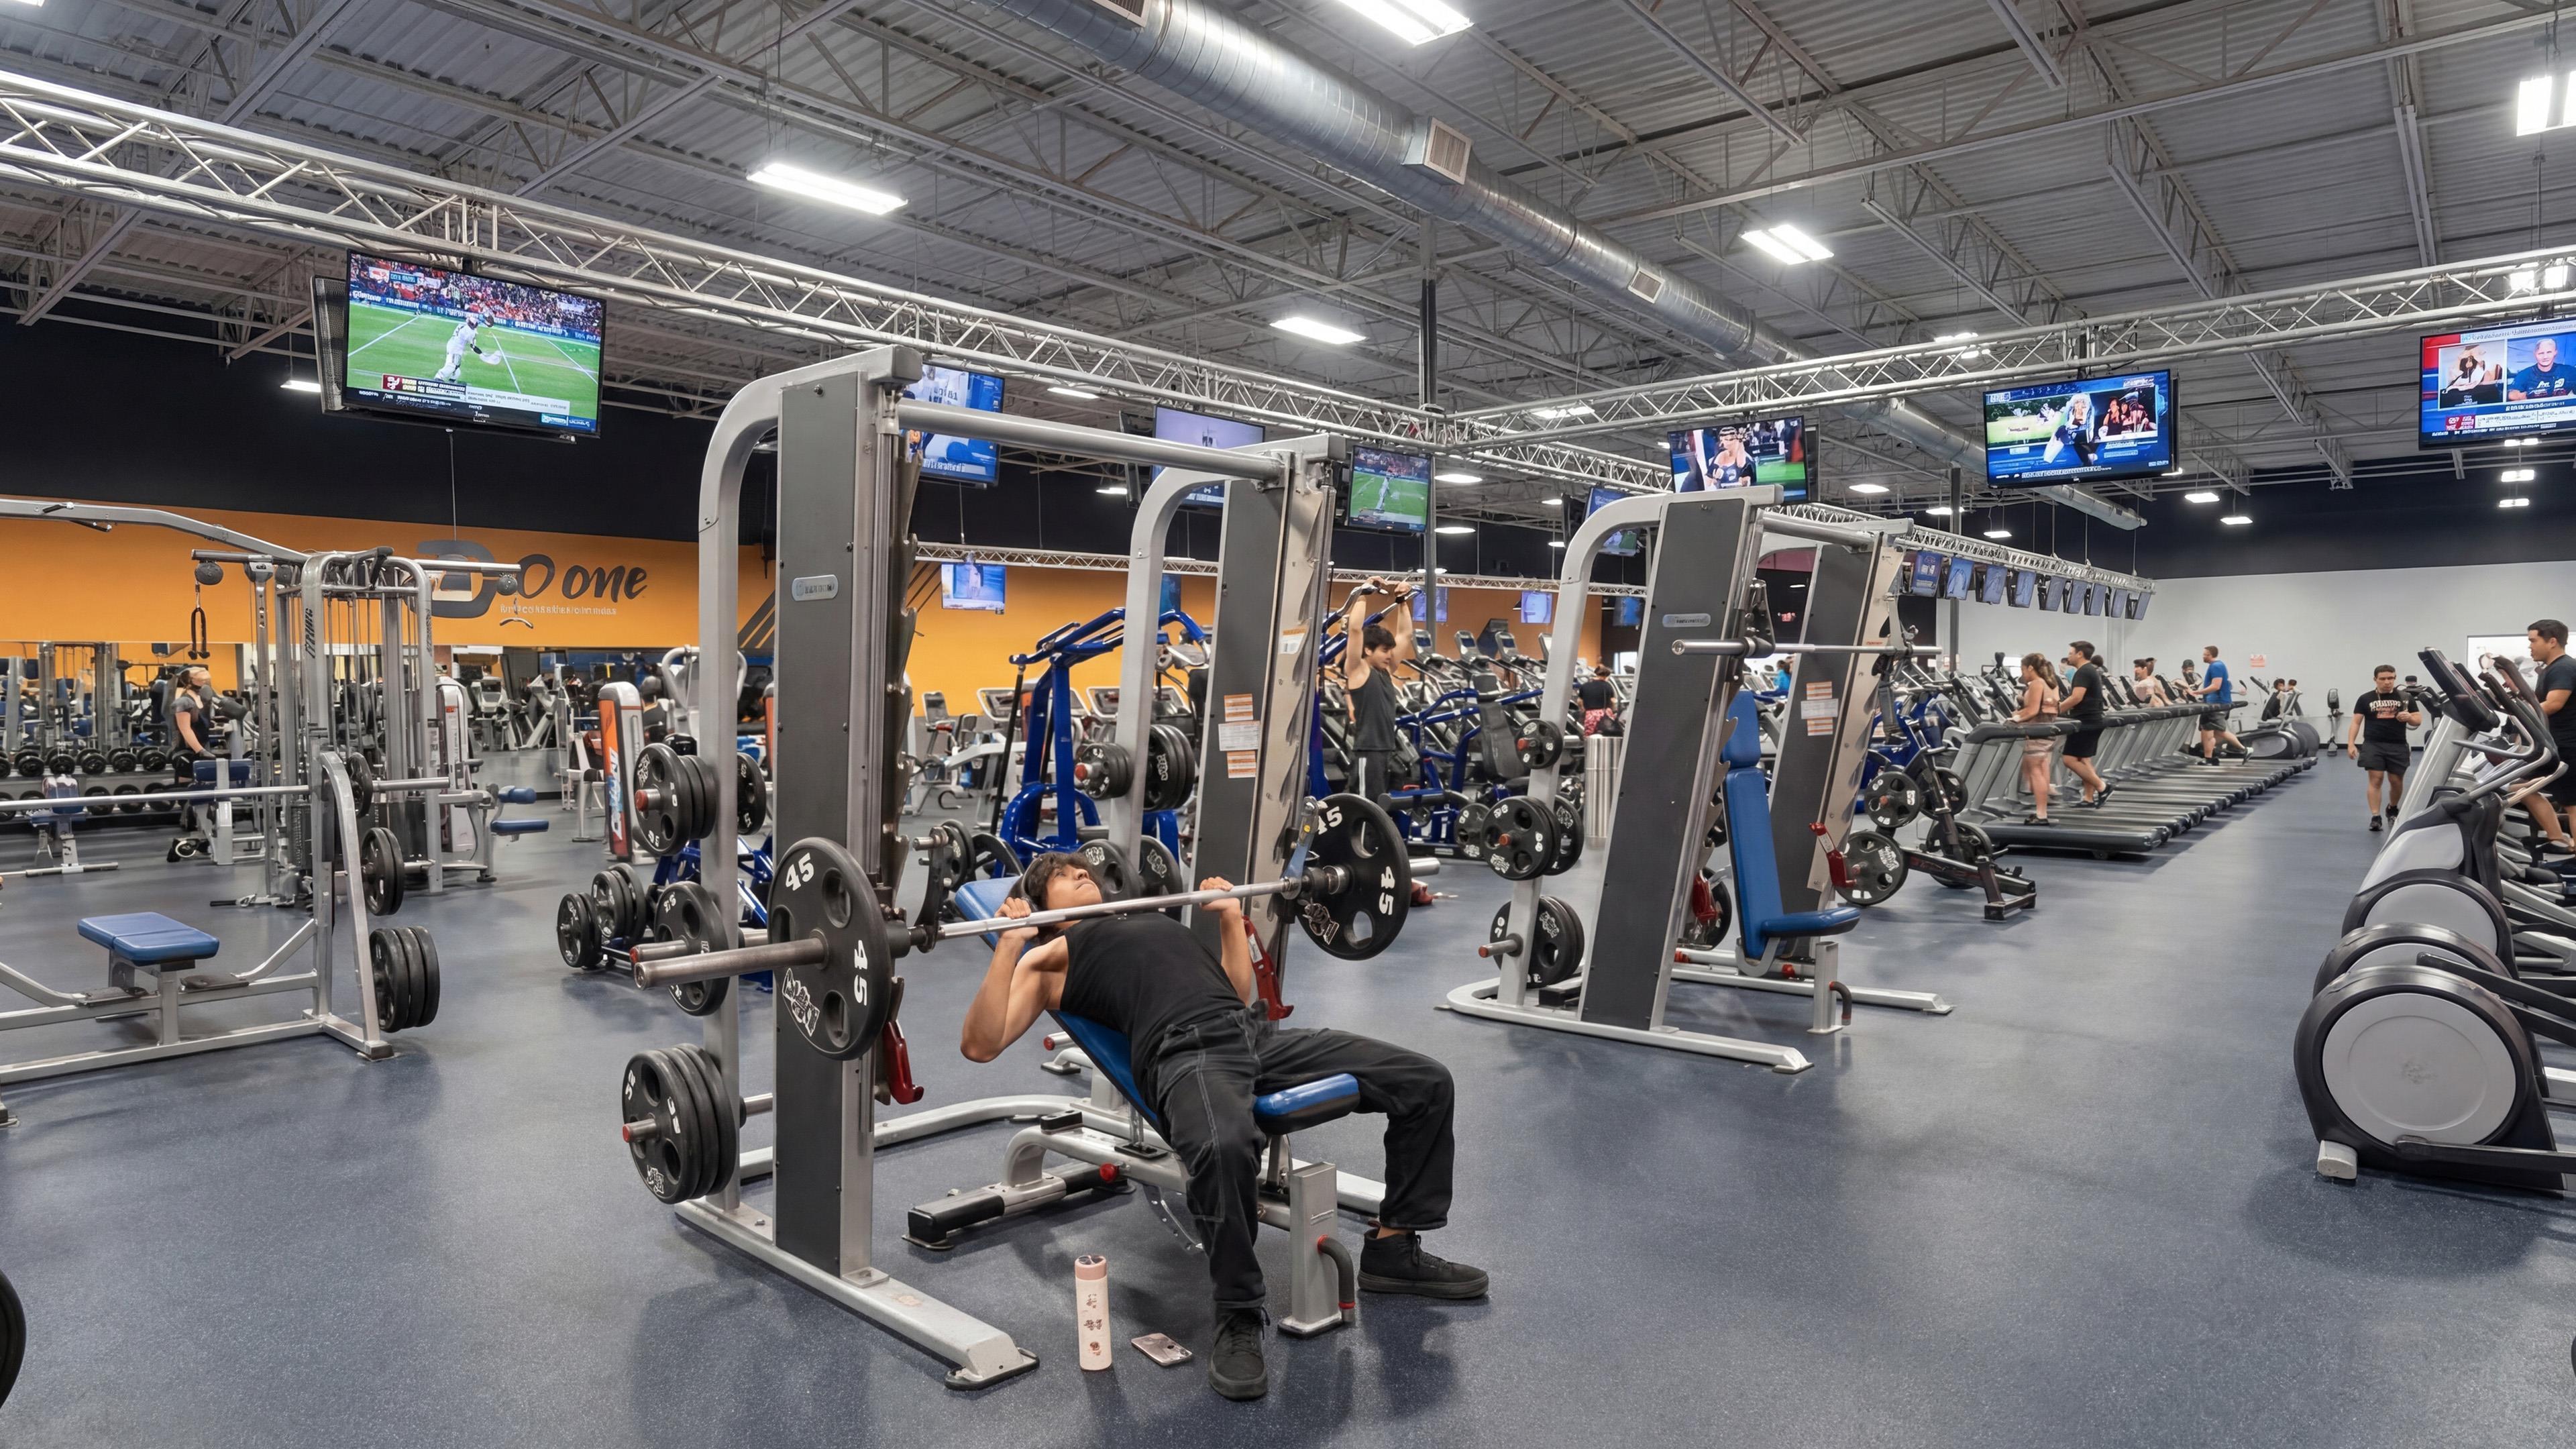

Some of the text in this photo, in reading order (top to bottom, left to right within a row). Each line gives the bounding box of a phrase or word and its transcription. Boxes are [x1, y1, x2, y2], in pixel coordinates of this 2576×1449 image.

[562, 565, 647, 602] one
[785, 853, 814, 891] 45
[1379, 865, 1396, 916] 45
[854, 939, 868, 1006] 45
